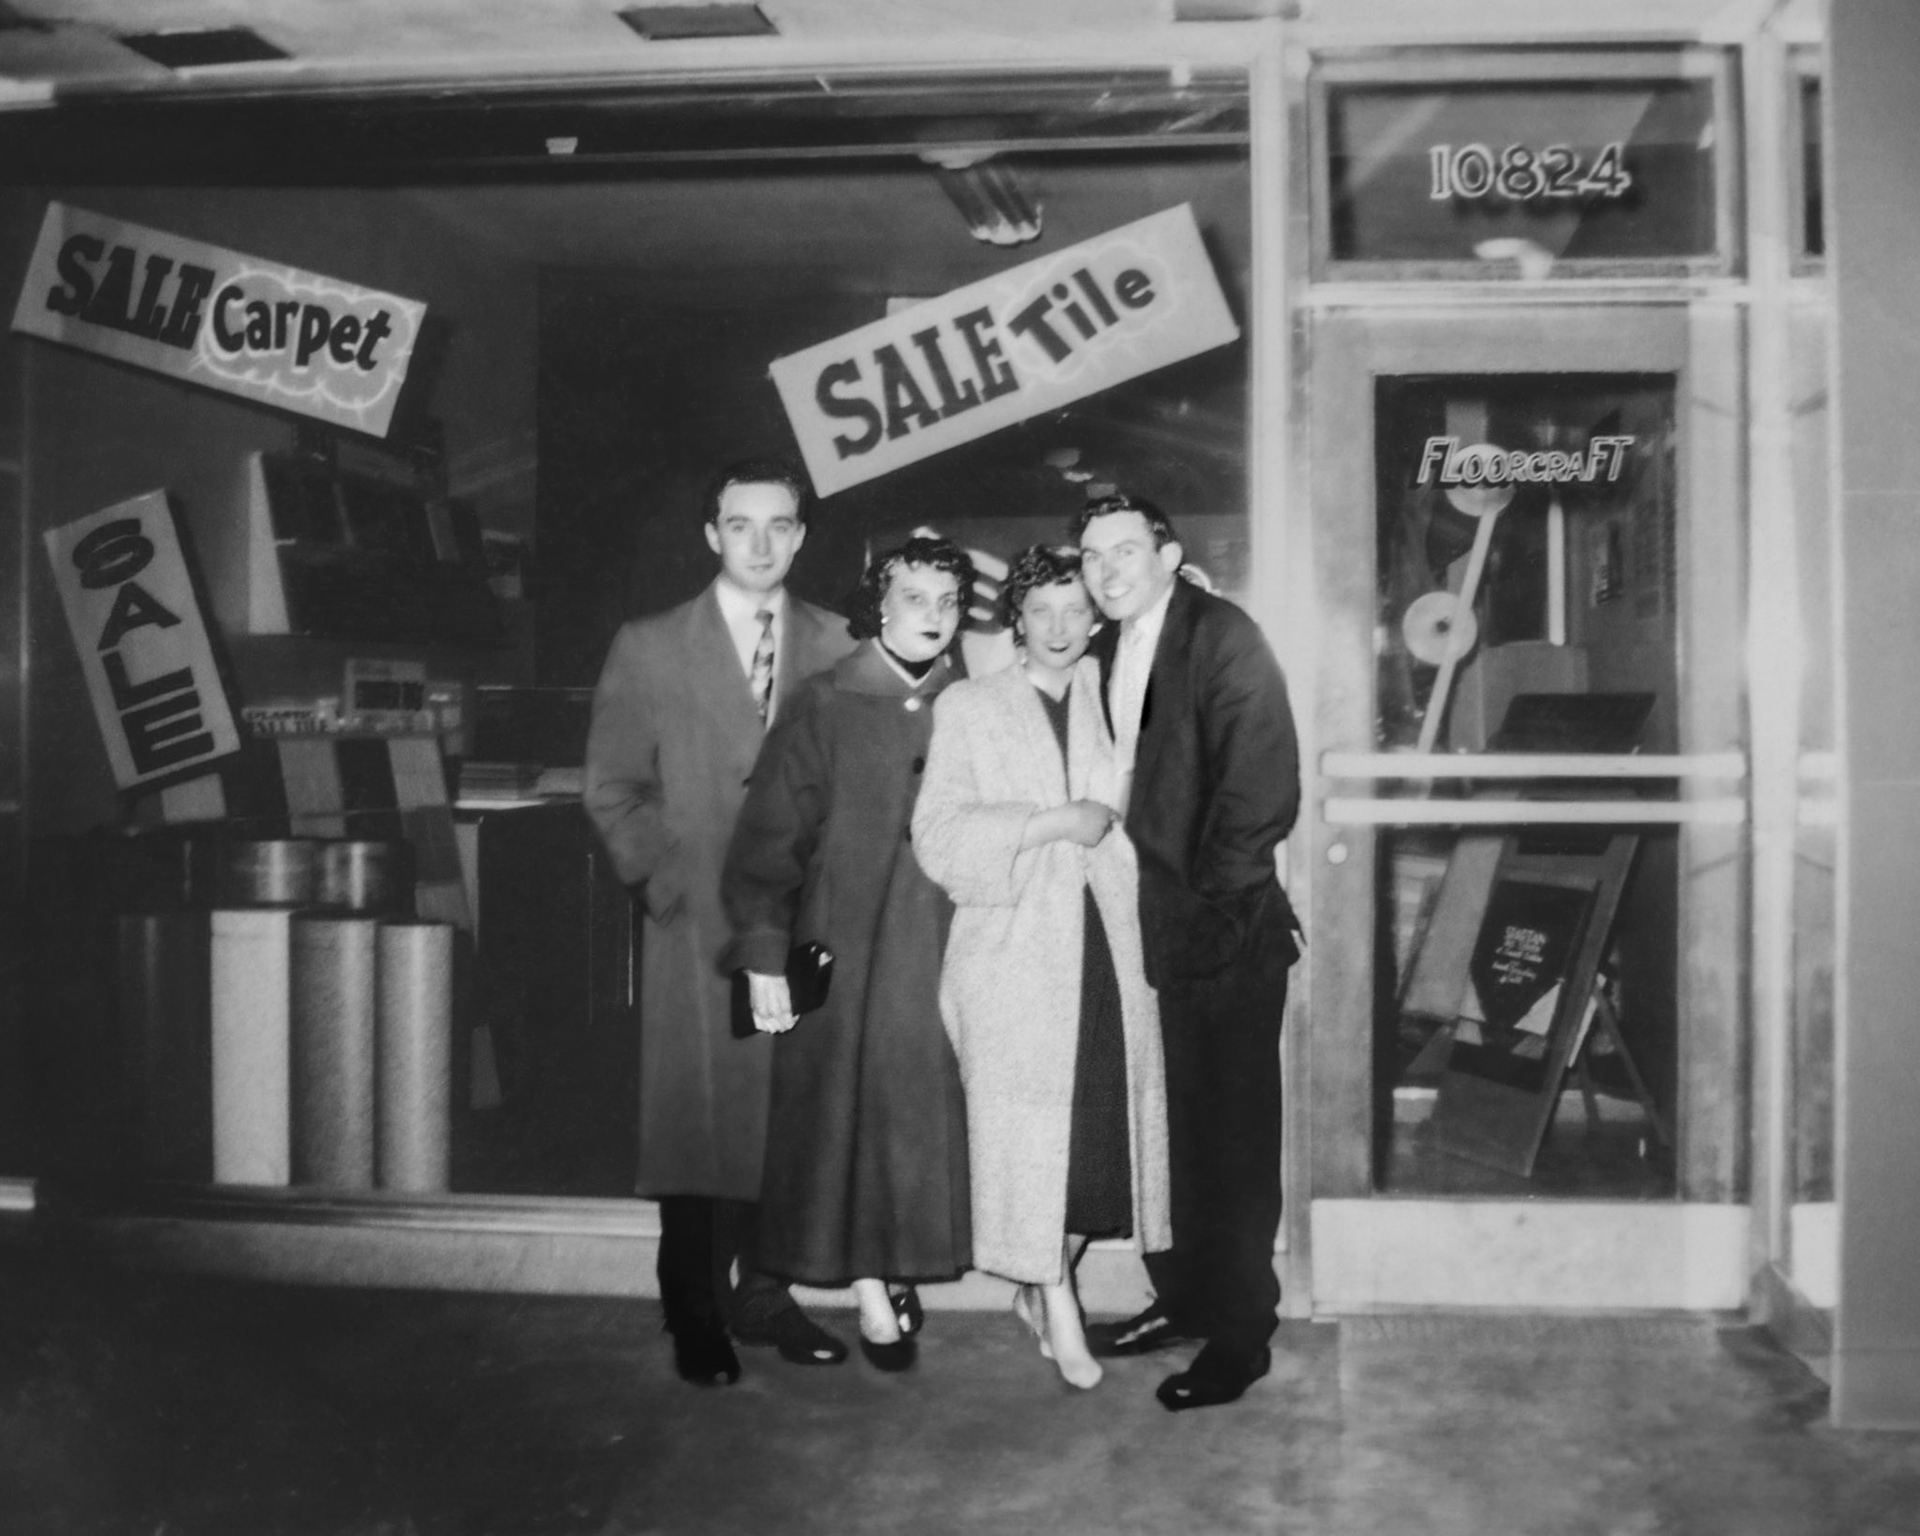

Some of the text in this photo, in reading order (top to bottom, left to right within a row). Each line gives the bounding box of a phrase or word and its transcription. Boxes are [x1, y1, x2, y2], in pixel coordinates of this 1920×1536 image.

[1429, 141, 1632, 199] 10824
[46, 234, 391, 371] SALE Carpet
[815, 268, 1156, 461] SALE Tile
[1416, 435, 1636, 484] FLOORCRAFT
[72, 518, 215, 776] SALE
